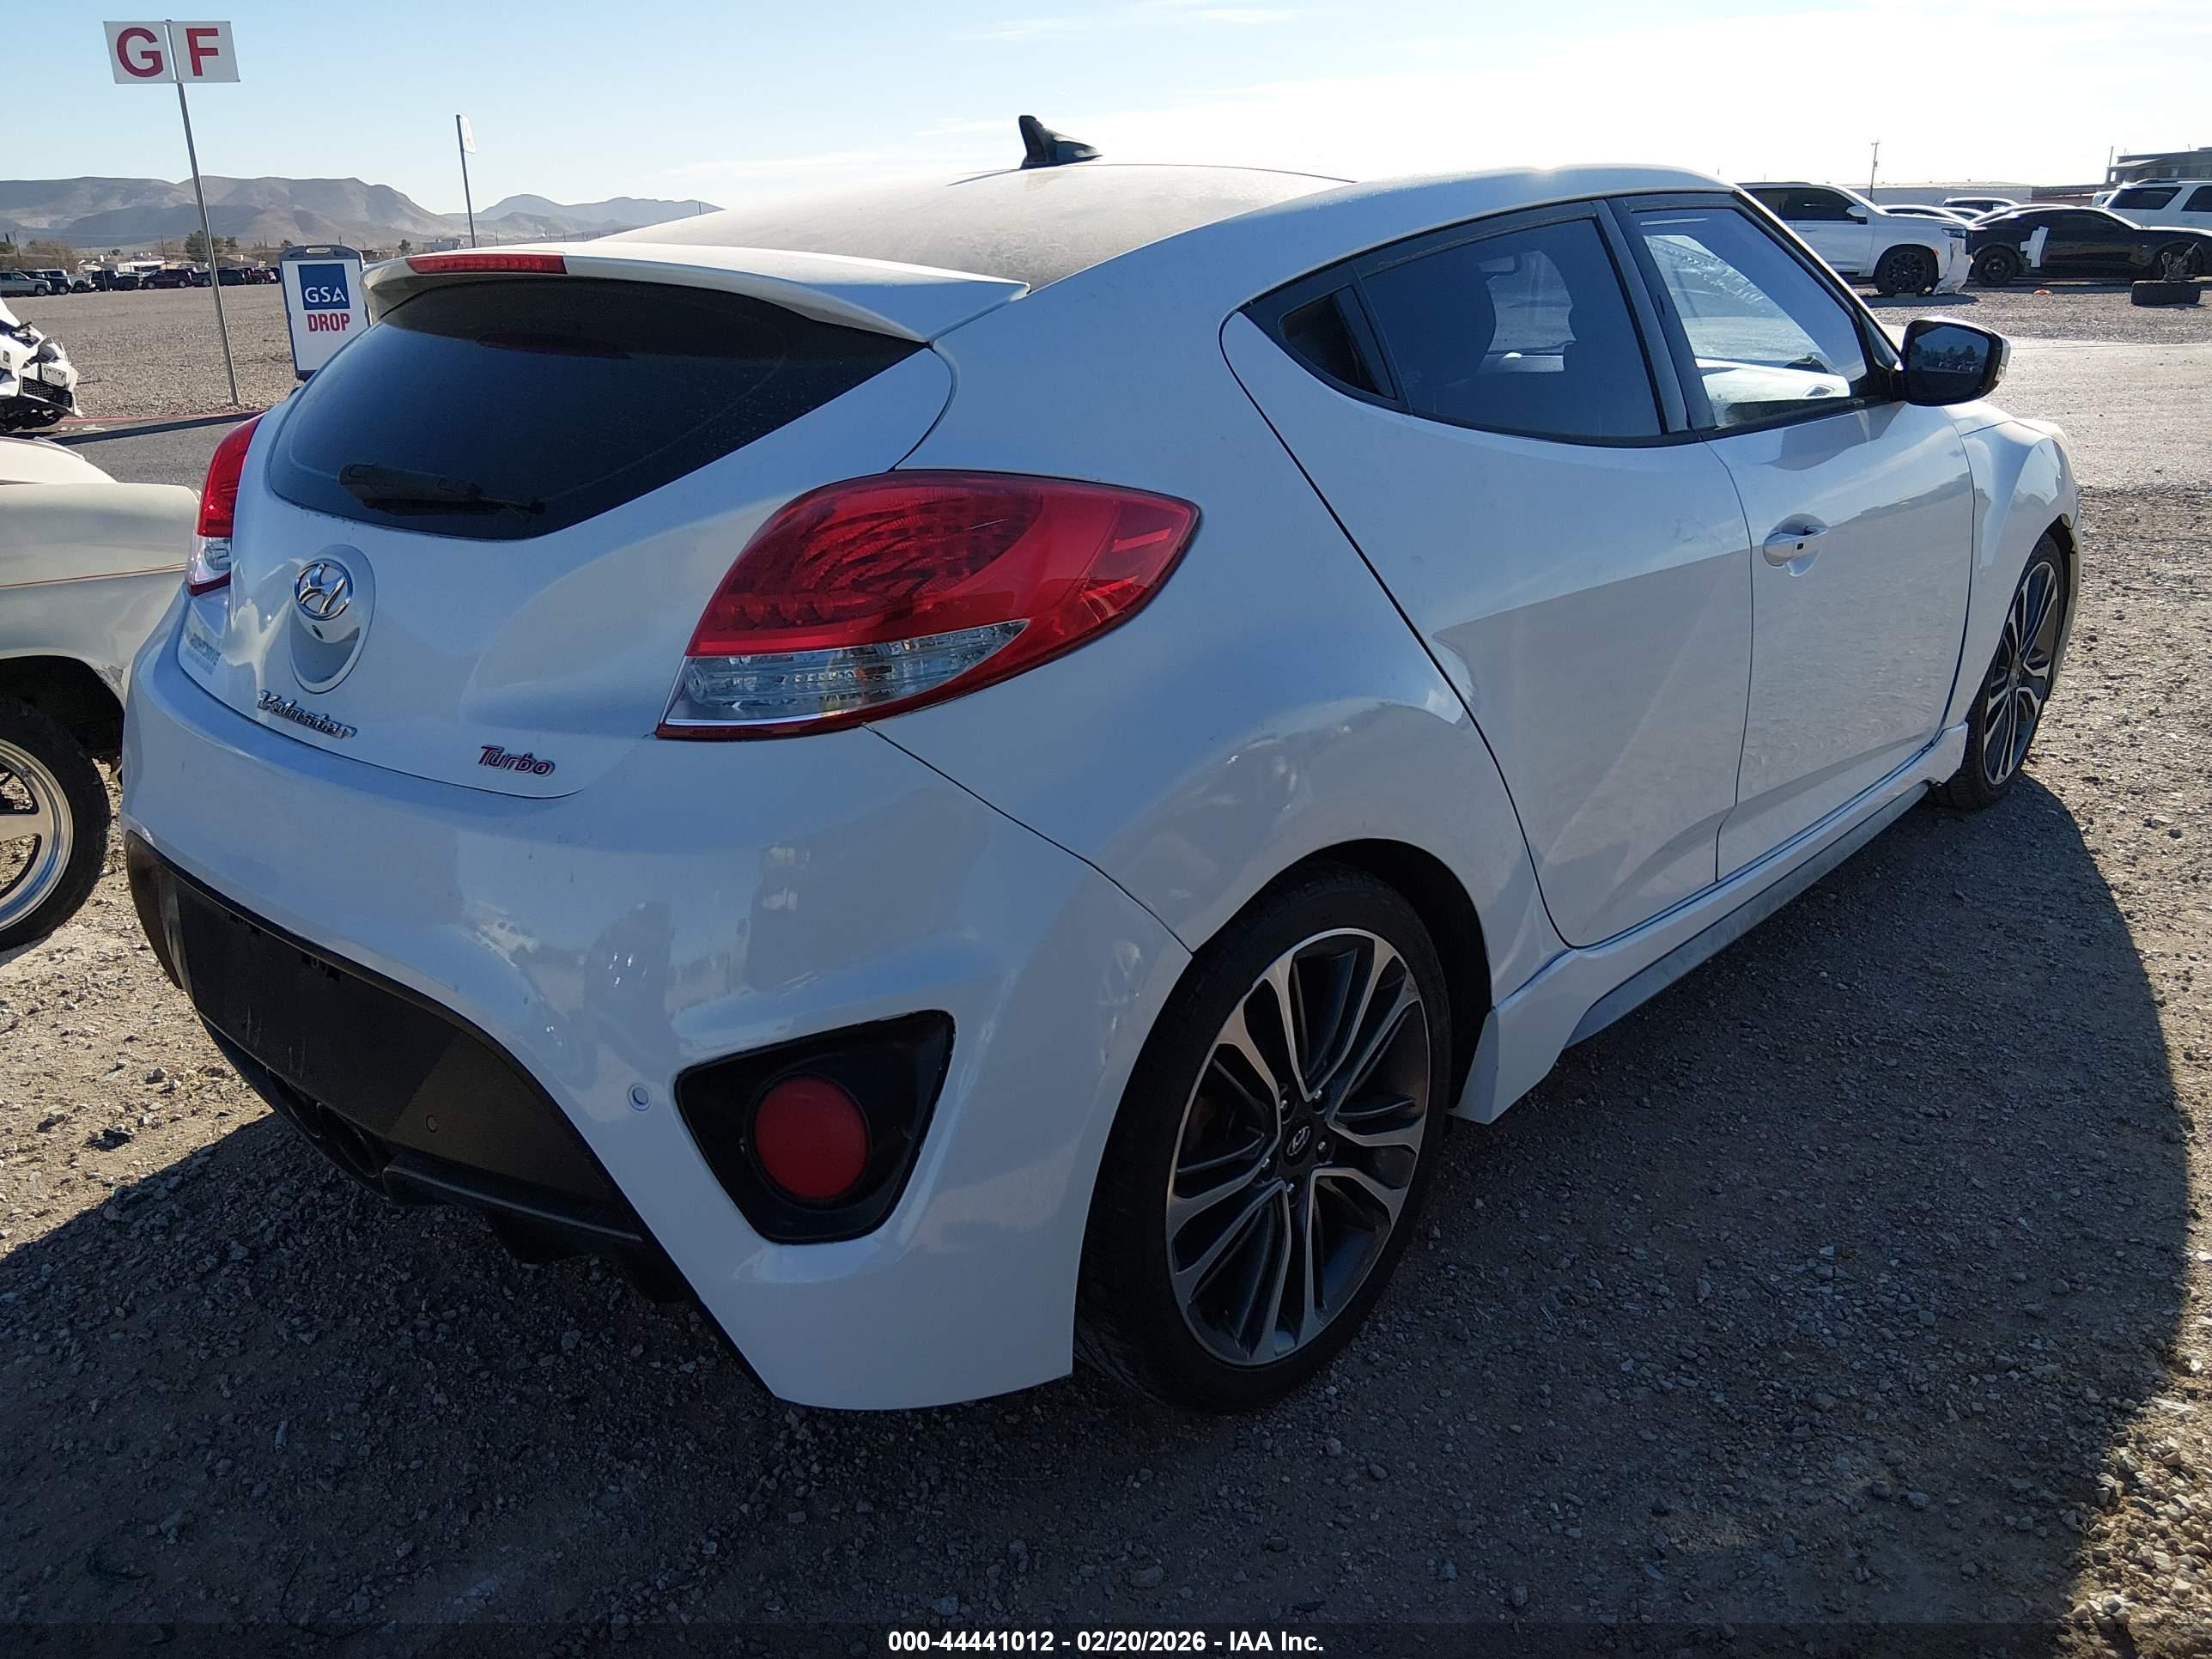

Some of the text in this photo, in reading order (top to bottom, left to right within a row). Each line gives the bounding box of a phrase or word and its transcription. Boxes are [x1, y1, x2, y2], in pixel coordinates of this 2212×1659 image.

[117, 27, 164, 78] G
[185, 27, 220, 76] F
[304, 286, 347, 303] GSA
[307, 313, 350, 332] DROP
[478, 744, 556, 777] Turbo
